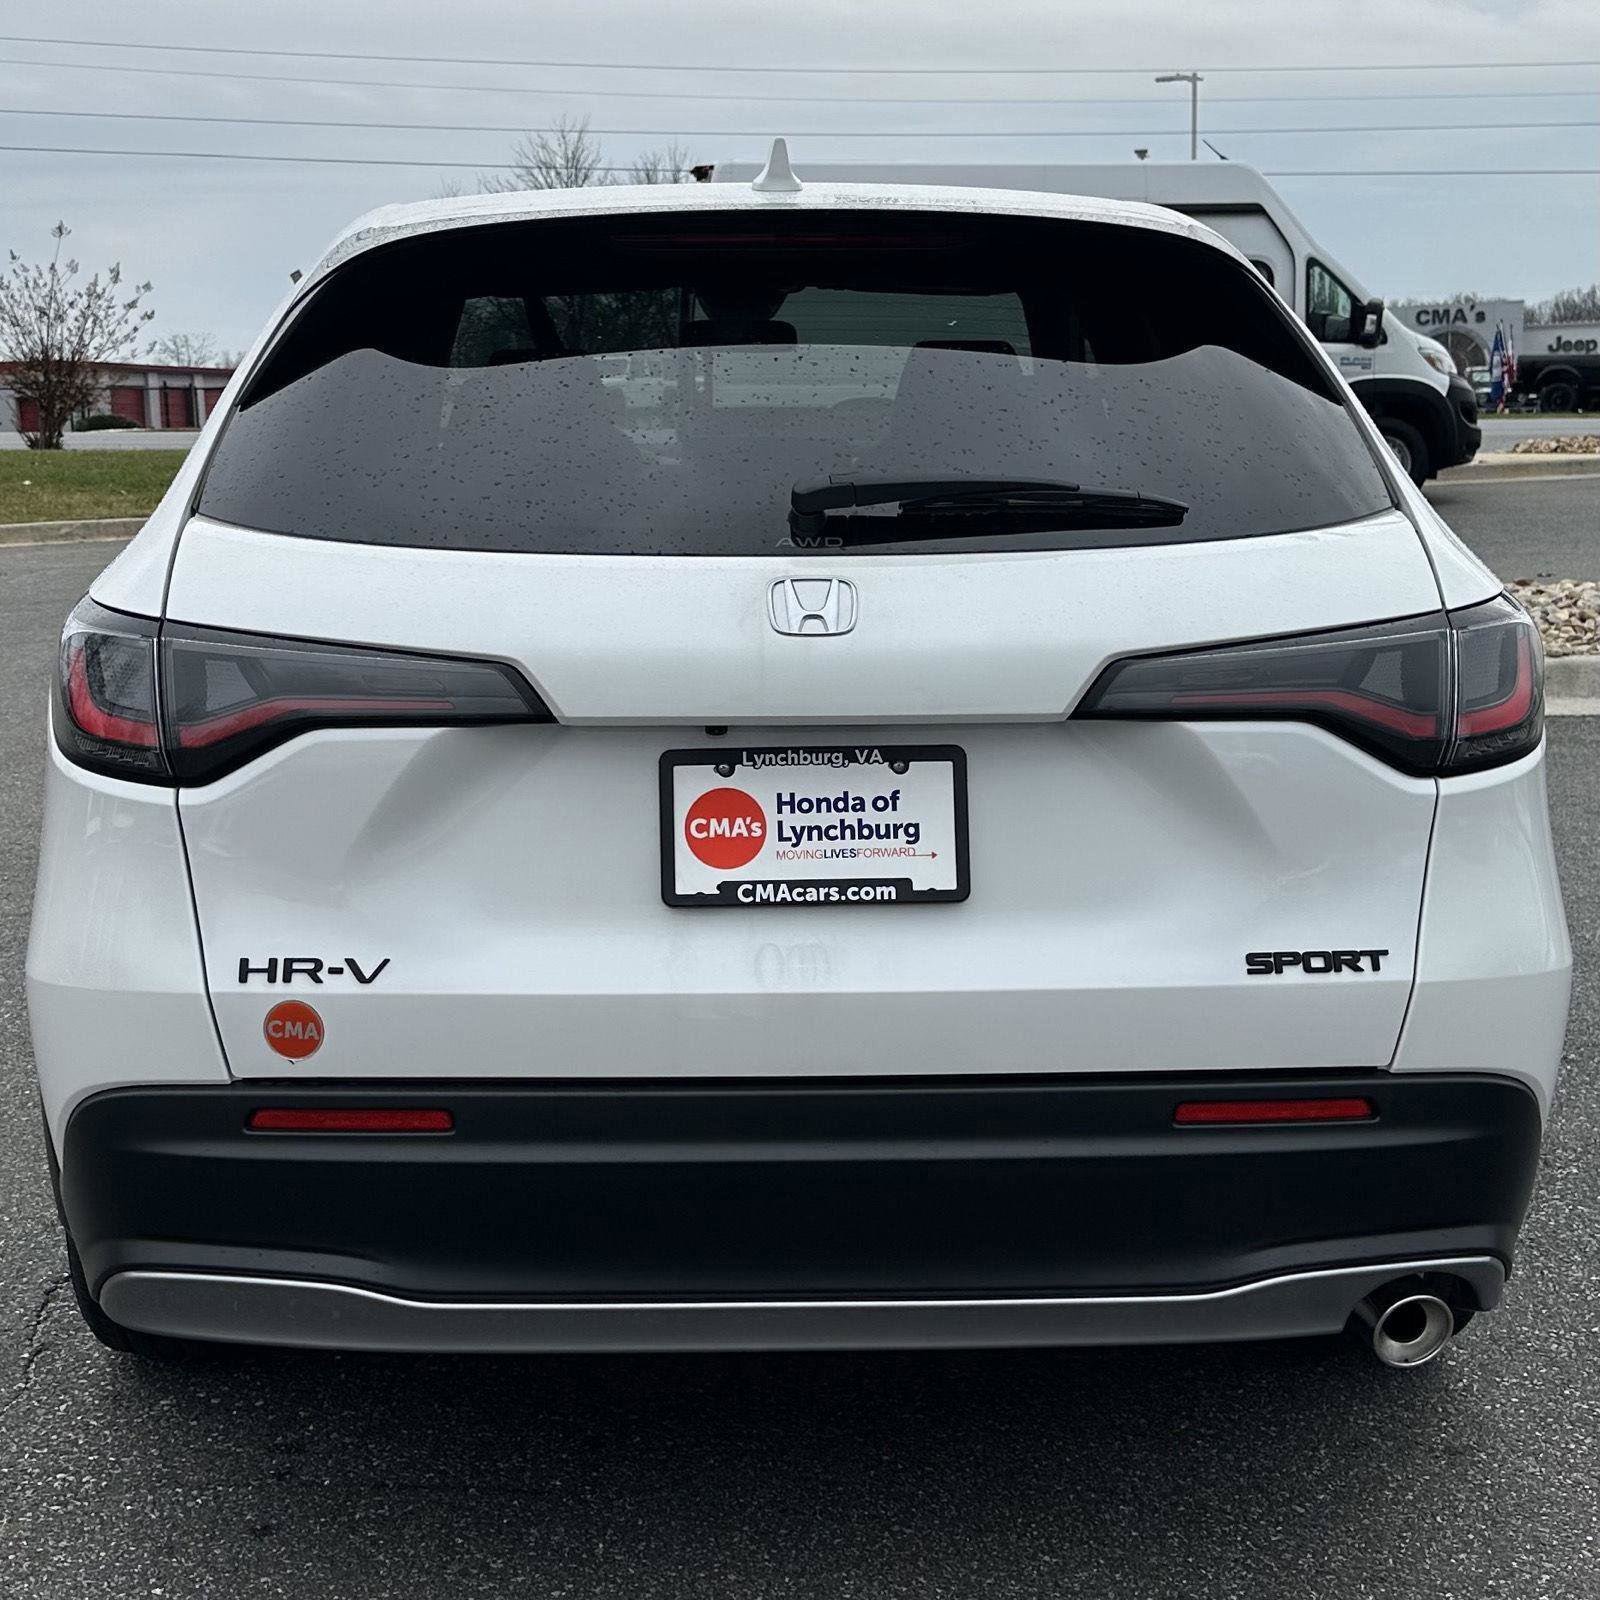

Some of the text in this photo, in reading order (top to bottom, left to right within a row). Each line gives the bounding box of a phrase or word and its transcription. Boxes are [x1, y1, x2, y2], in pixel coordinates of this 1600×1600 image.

[1415, 305, 1486, 326] CMA's
[1548, 335, 1598, 354] Jeep
[775, 536, 844, 548] AWD
[741, 748, 884, 769] Lynchburg, VA
[775, 789, 901, 815] Honda of
[689, 817, 763, 839] CMA's
[776, 818, 921, 848] Lynchburg
[736, 883, 897, 904] CMAcars.com
[238, 957, 391, 984] HR-V
[1245, 949, 1390, 975] SPORT
[268, 1019, 320, 1041] CMA
